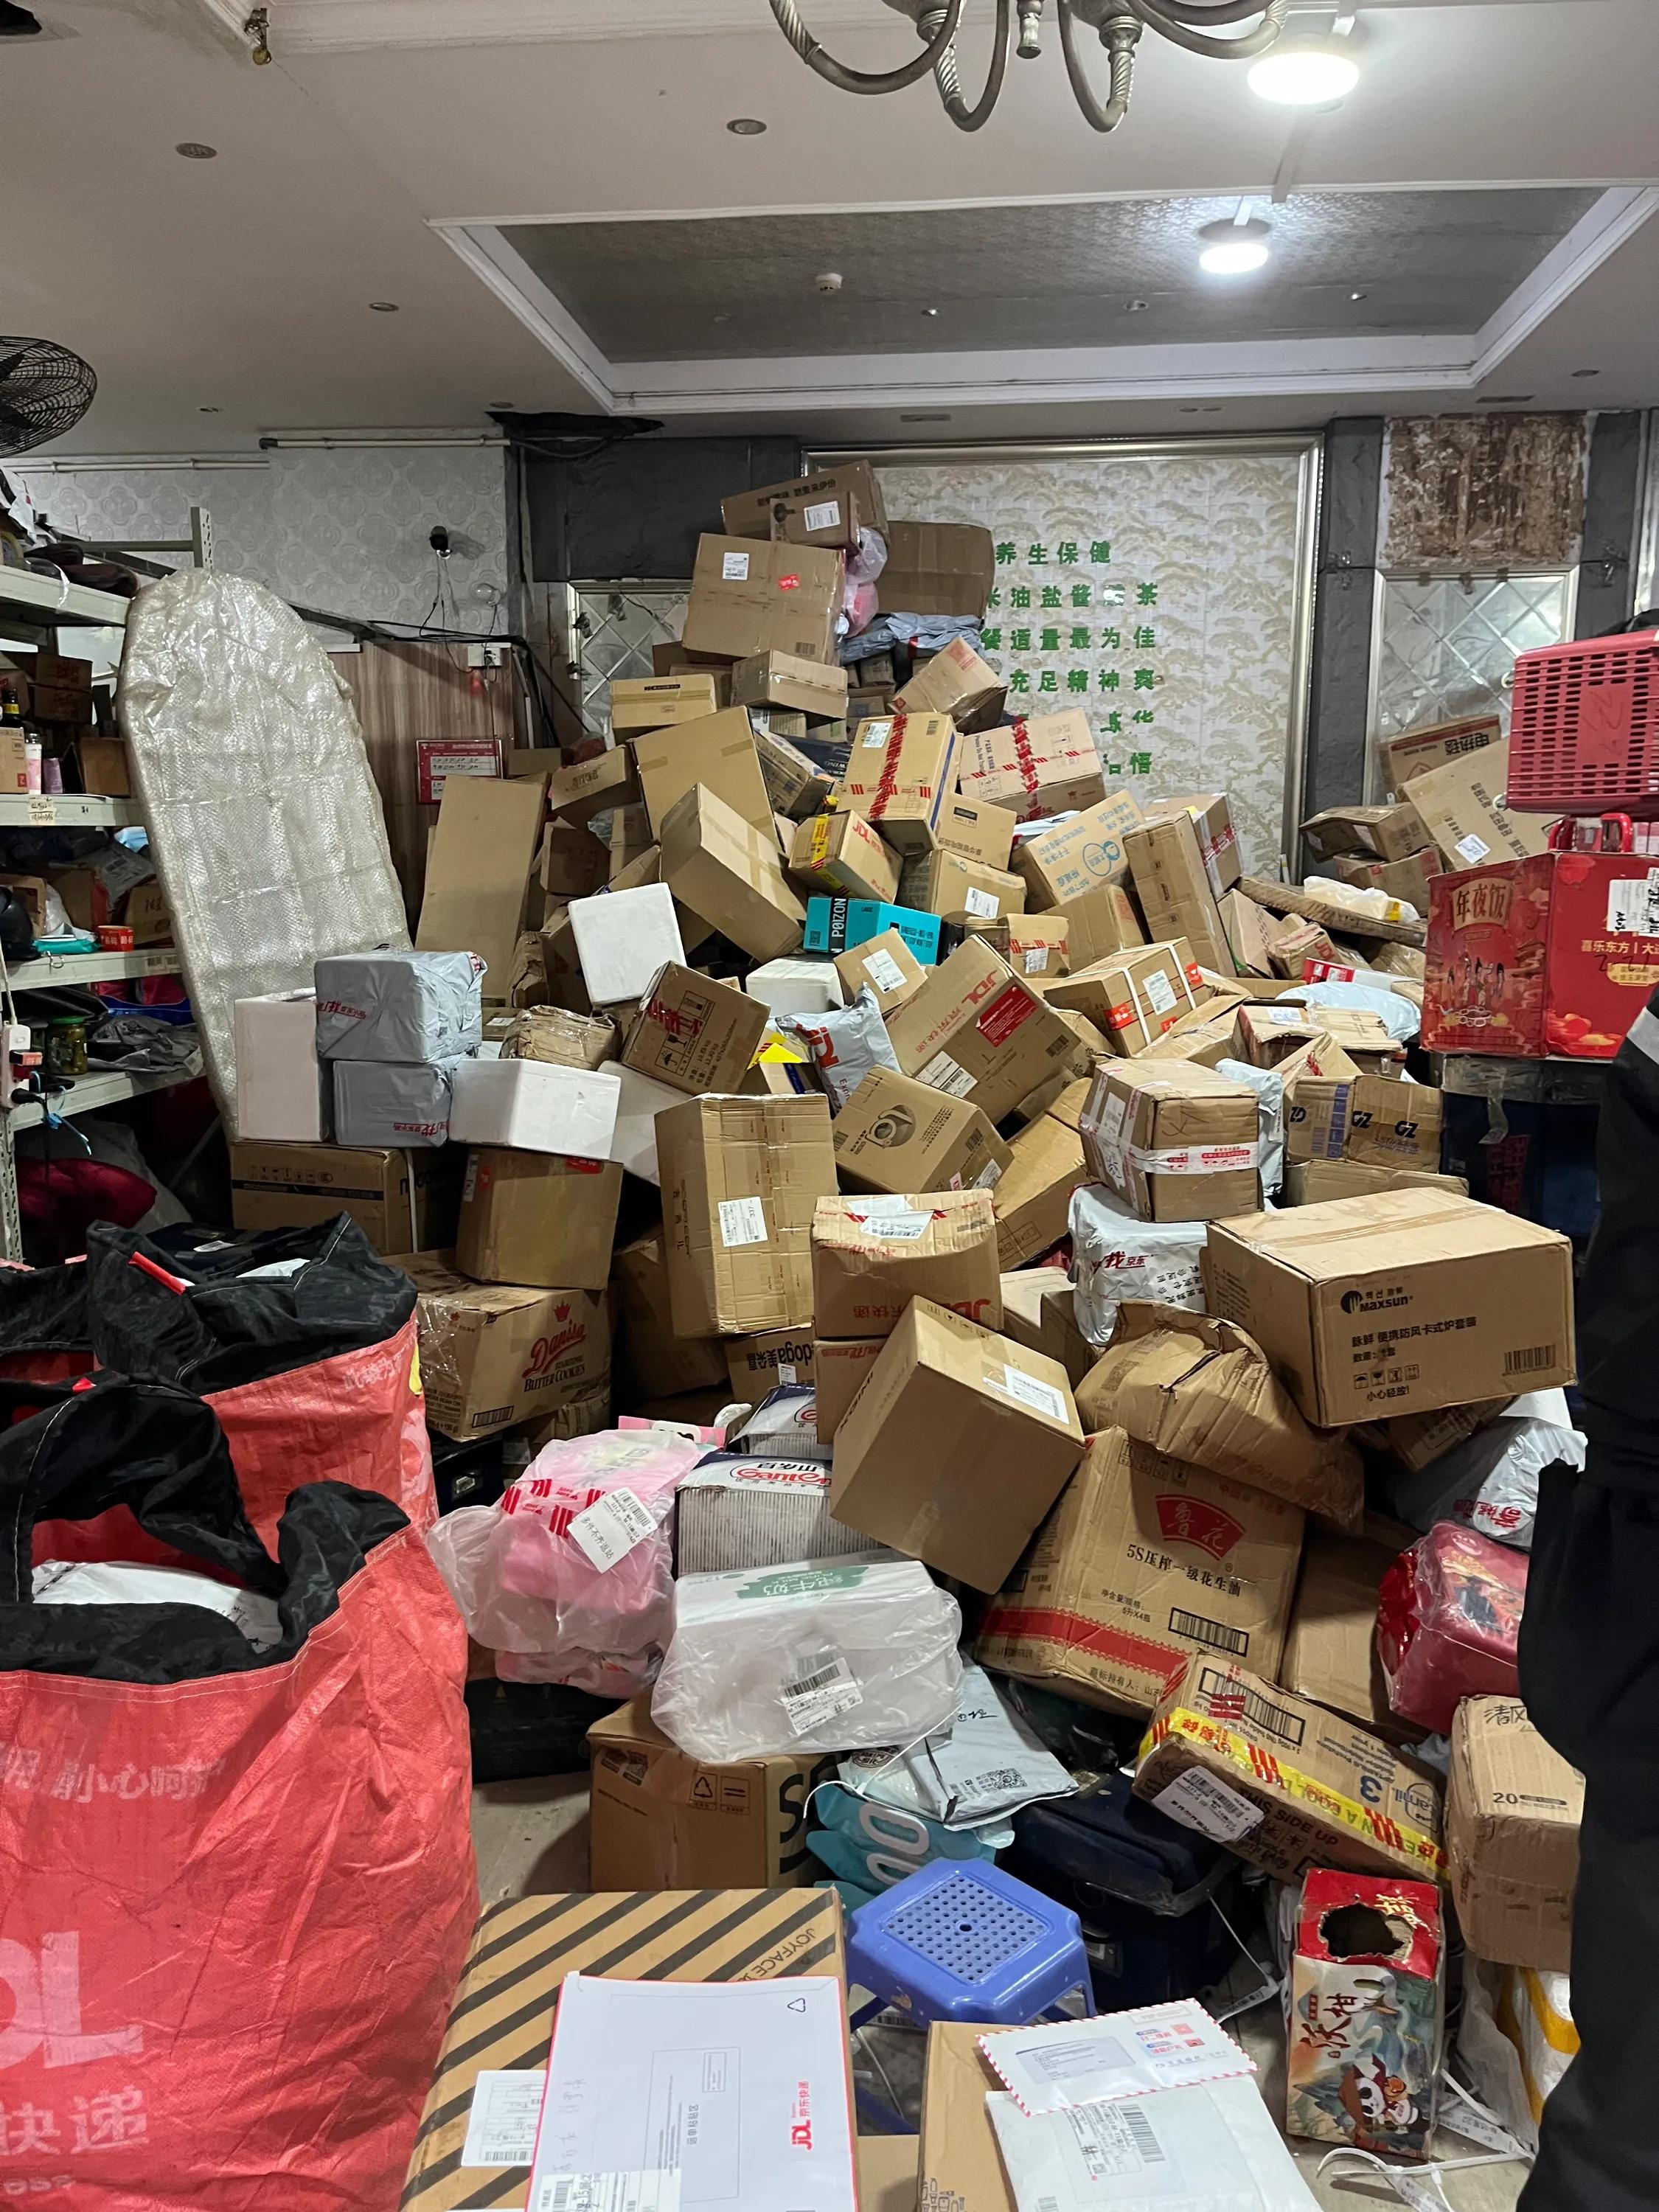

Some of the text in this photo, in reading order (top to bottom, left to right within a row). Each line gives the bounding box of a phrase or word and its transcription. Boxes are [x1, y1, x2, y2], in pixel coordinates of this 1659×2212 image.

[995, 540, 1111, 566] 养生保健
[980, 626, 1156, 651] 餐适量最为佳
[1455, 882, 1507, 926] 年夜饭
[1359, 1295, 1409, 1312] Maxsun
[778, 1340, 814, 1368] doga
[524, 1363, 586, 1394] BUTTER COOKIES
[1126, 1543, 1242, 1598] 5S压榨一级花生油
[1360, 1774, 1382, 1803] 3
[1493, 1792, 1519, 1805] 20
[1275, 1809, 1314, 1834] SIDE
[1315, 1829, 1339, 1846] UP
[751, 1927, 815, 1977] JOYFACE
[790, 2119, 813, 2151] JDL
